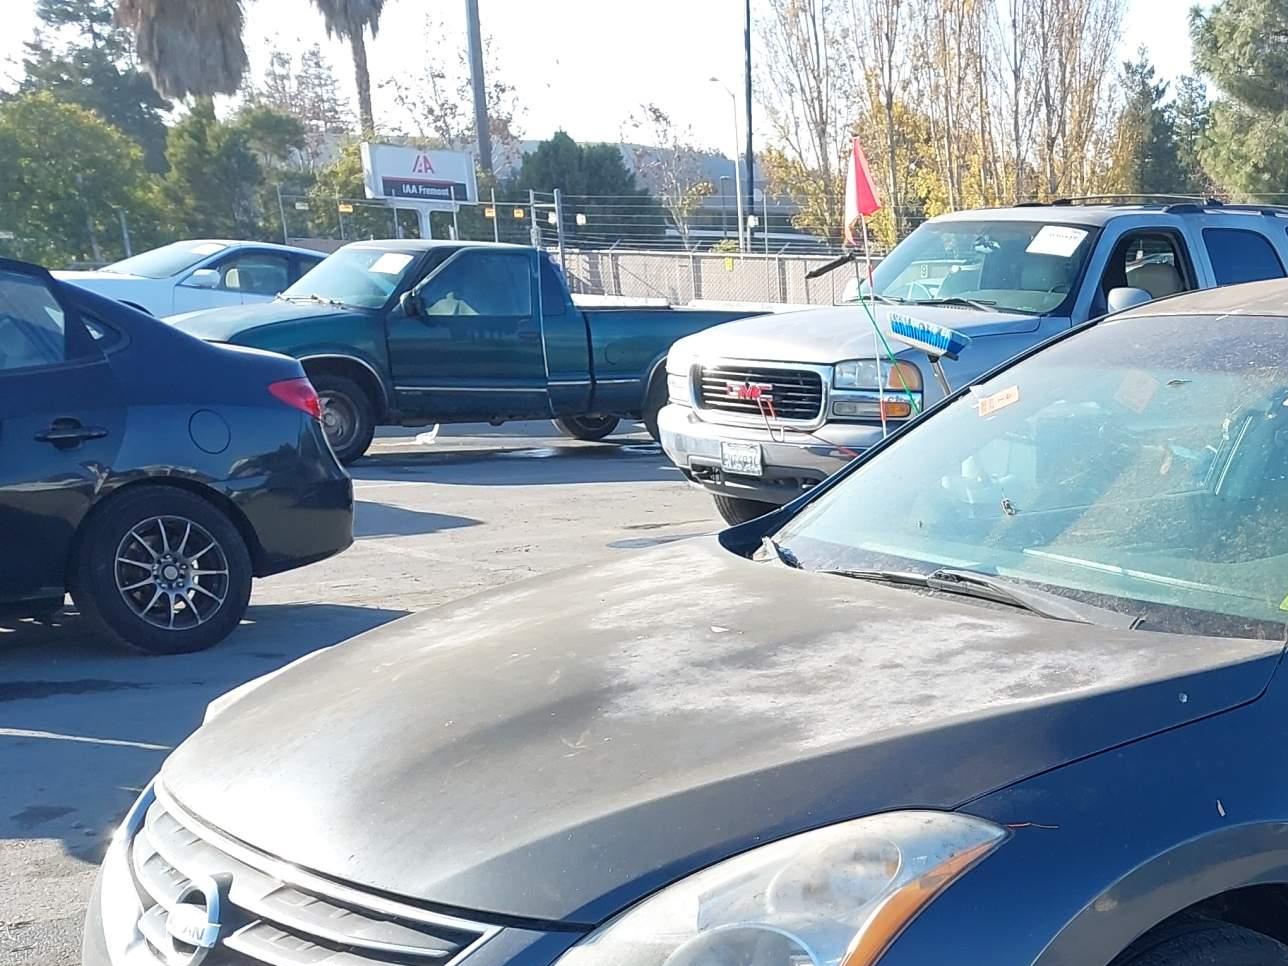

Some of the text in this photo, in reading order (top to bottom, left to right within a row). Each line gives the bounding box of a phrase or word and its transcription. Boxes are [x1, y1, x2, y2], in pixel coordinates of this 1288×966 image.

[402, 184, 449, 197] IAA Fremont
[726, 383, 773, 401] GMC
